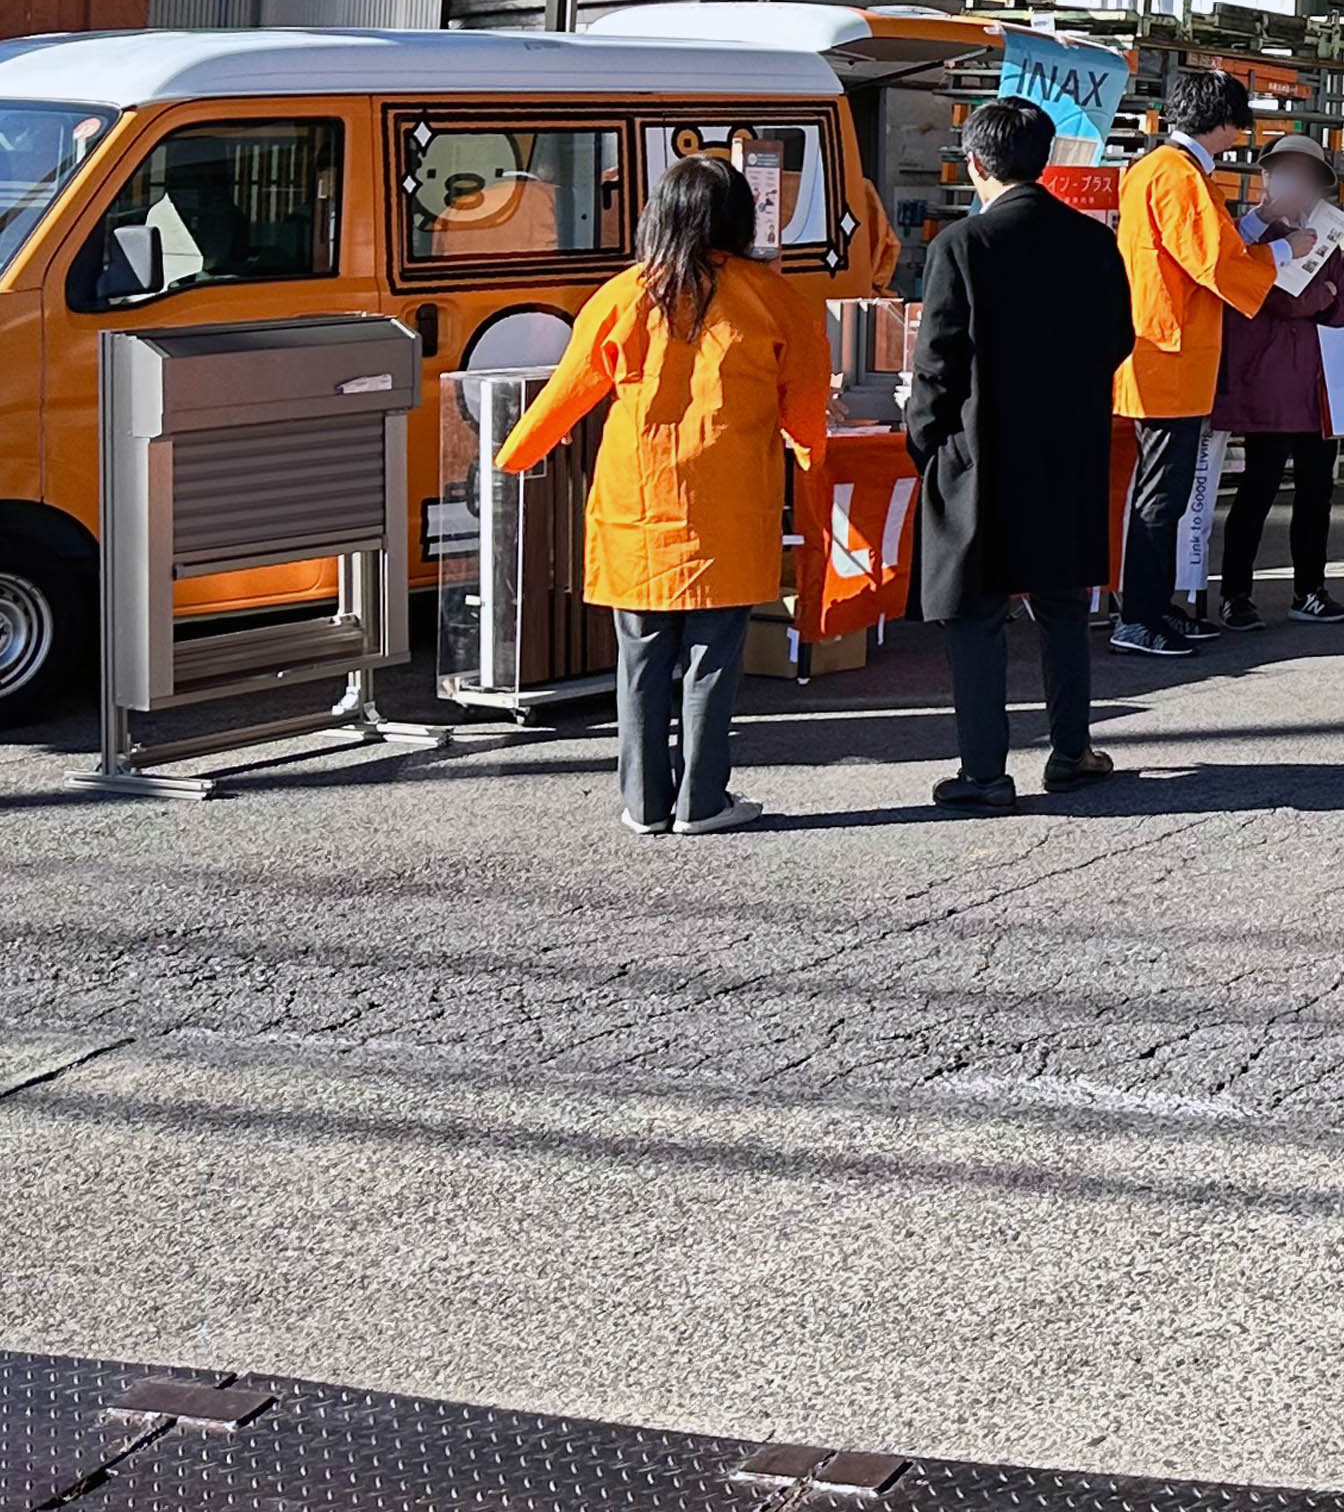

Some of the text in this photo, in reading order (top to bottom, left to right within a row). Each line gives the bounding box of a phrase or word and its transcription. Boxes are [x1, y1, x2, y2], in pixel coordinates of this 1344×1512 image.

[1015, 58, 1110, 108] INAX
[1191, 476, 1208, 513] Good
[1191, 518, 1203, 533] to
[1190, 538, 1202, 565] Link
